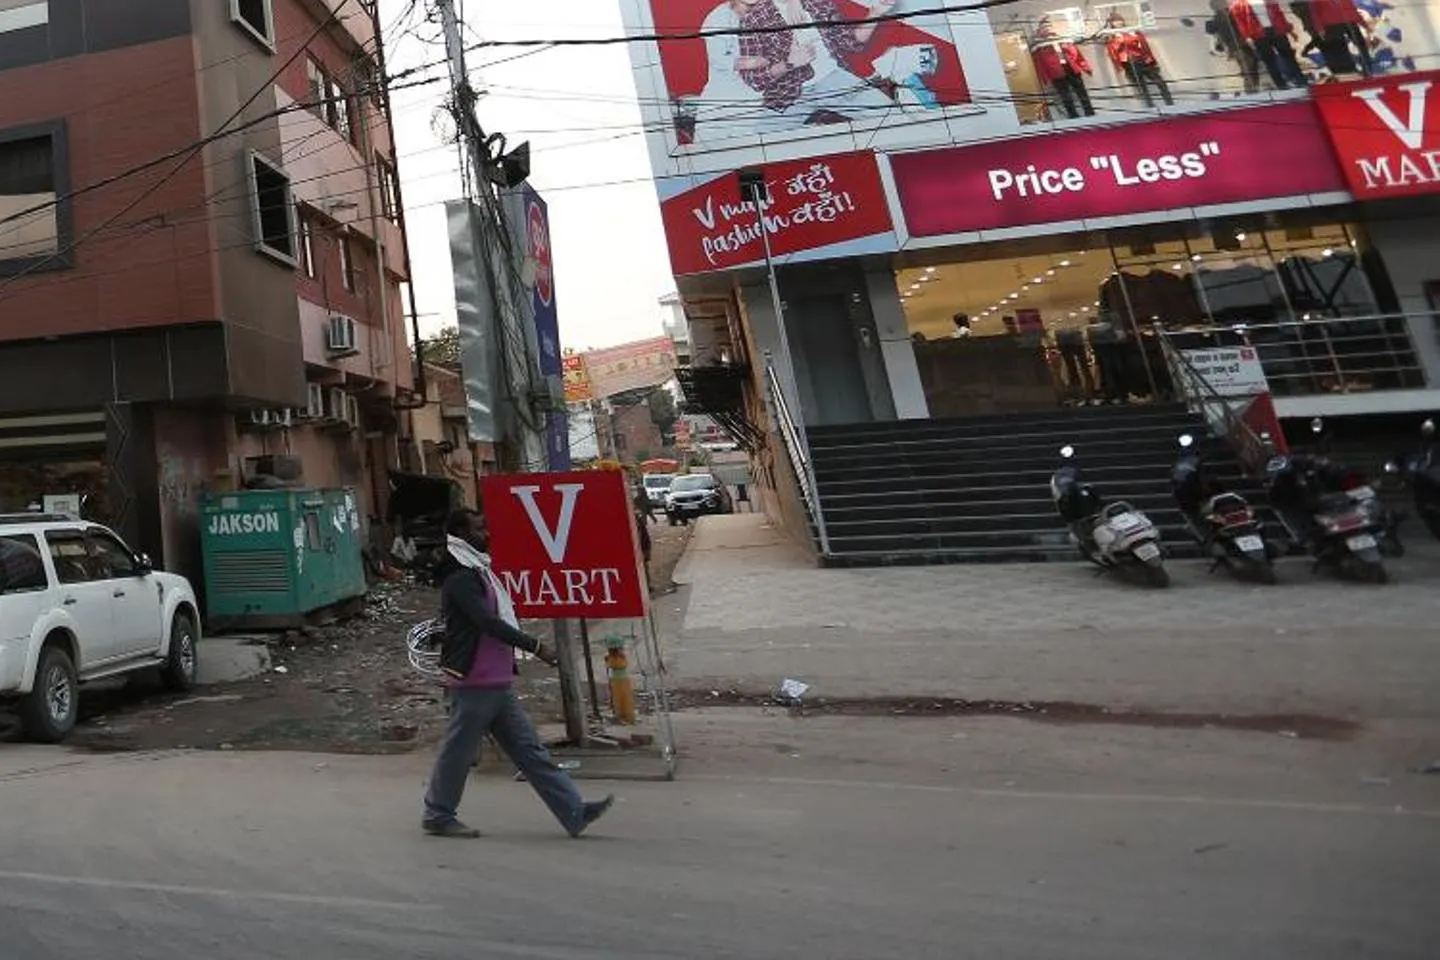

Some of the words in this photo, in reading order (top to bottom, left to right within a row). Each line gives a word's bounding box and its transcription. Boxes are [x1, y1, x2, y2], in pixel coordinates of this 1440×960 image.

[1351, 81, 1433, 150] V
[987, 164, 1085, 201] Price
[1090, 141, 1221, 186] "Less"
[692, 194, 717, 230] V
[209, 512, 280, 535] JAKSON
[510, 483, 585, 564] V
[499, 567, 623, 607] MART
